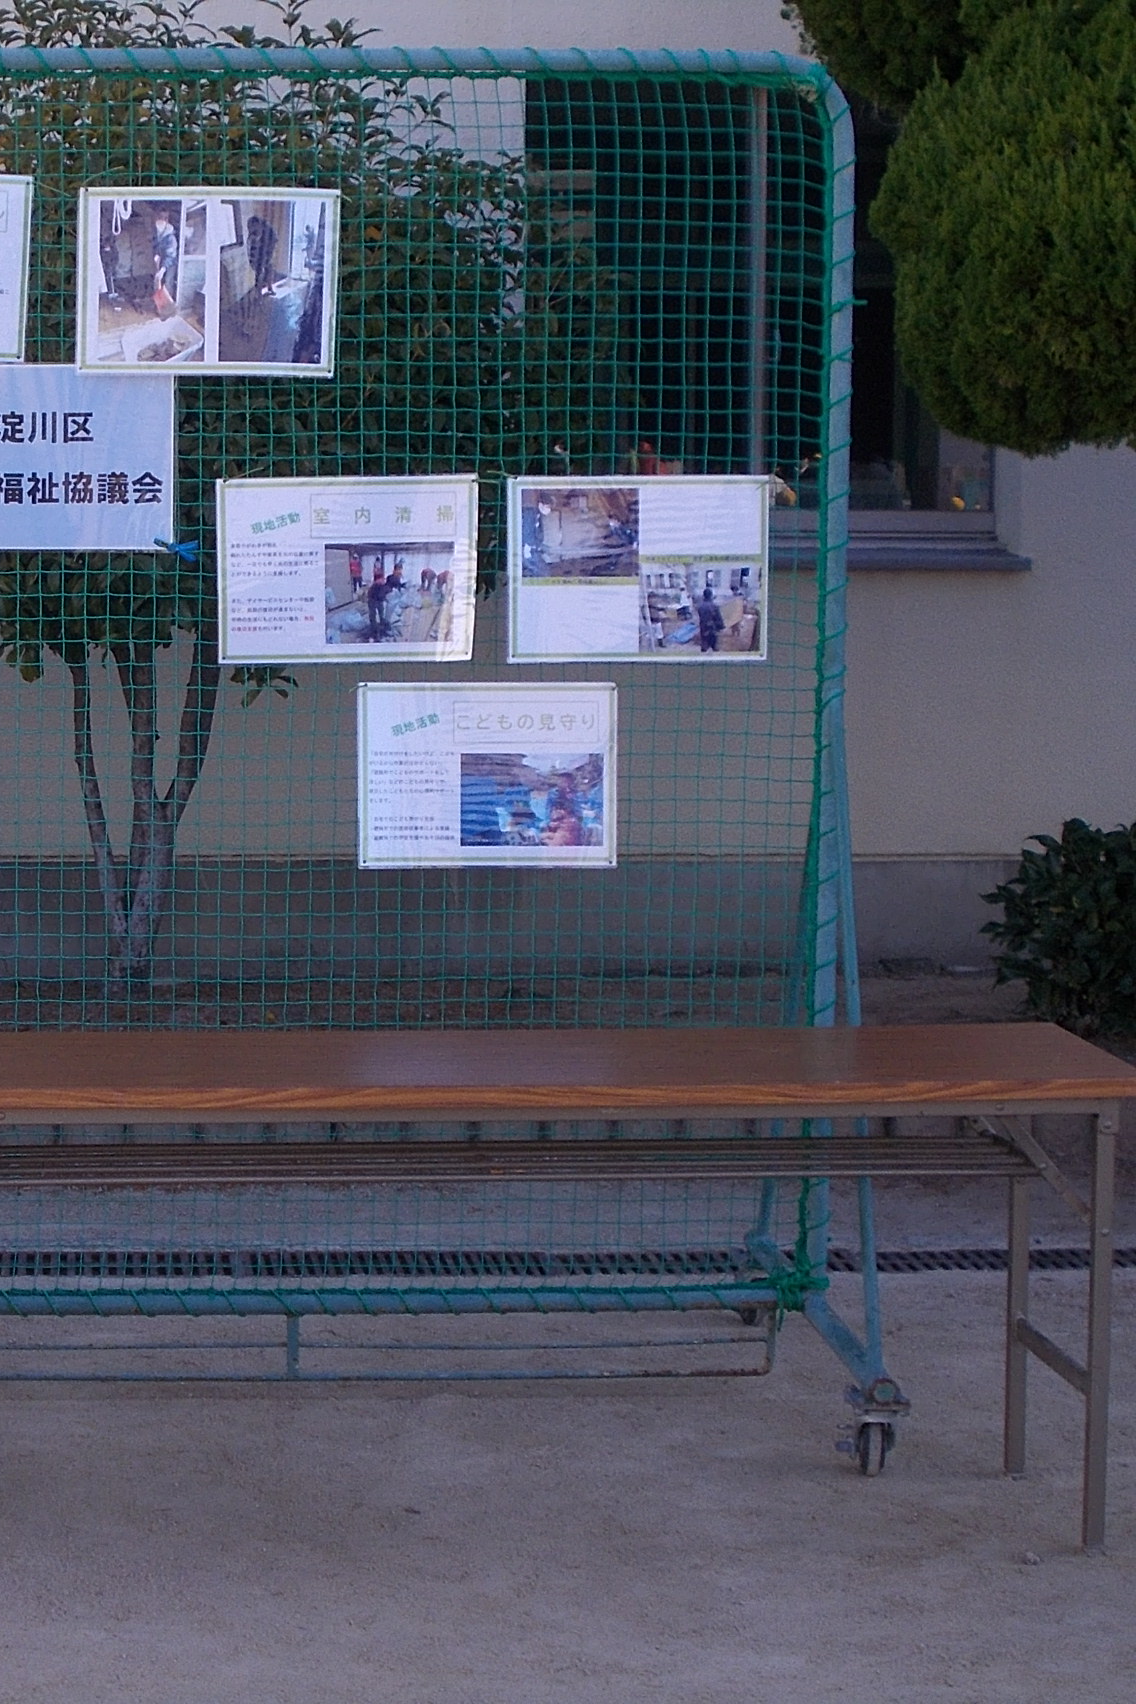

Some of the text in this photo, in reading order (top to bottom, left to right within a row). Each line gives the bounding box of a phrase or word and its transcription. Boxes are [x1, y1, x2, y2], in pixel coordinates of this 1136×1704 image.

[251, 511, 301, 535] 現地活動
[314, 506, 454, 525] 室内清掃
[391, 713, 440, 737] 現地活動
[456, 712, 596, 731] こどもの見守り
